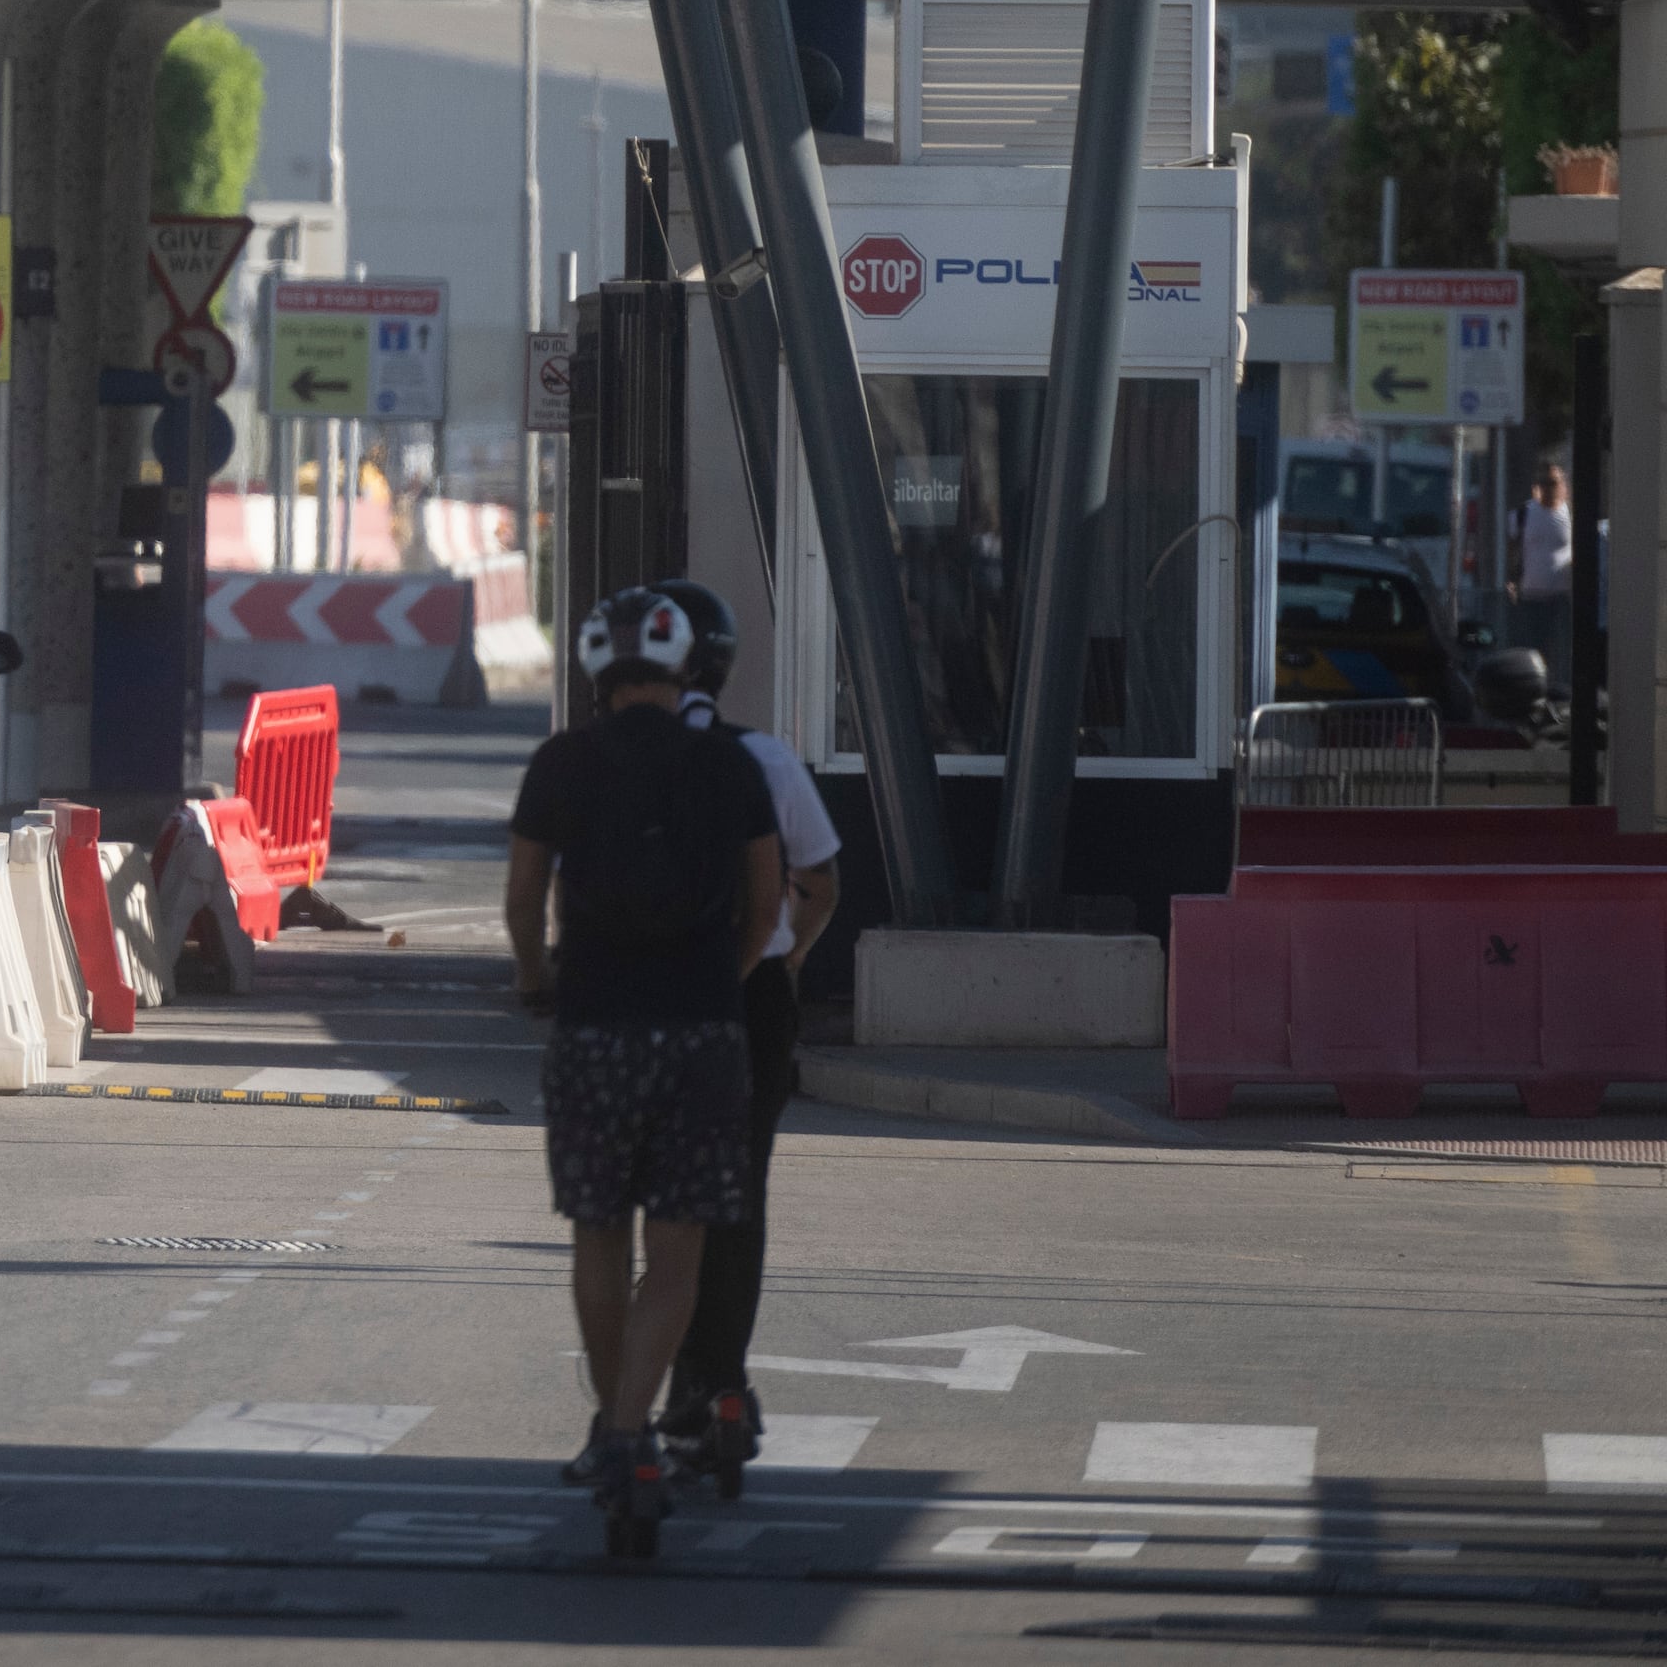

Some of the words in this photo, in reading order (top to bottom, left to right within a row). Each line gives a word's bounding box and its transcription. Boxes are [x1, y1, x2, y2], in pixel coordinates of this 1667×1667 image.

[158, 229, 221, 251] GIVE
[169, 255, 216, 272] WAY
[849, 259, 917, 293] STOP
[533, 339, 550, 353] NO
